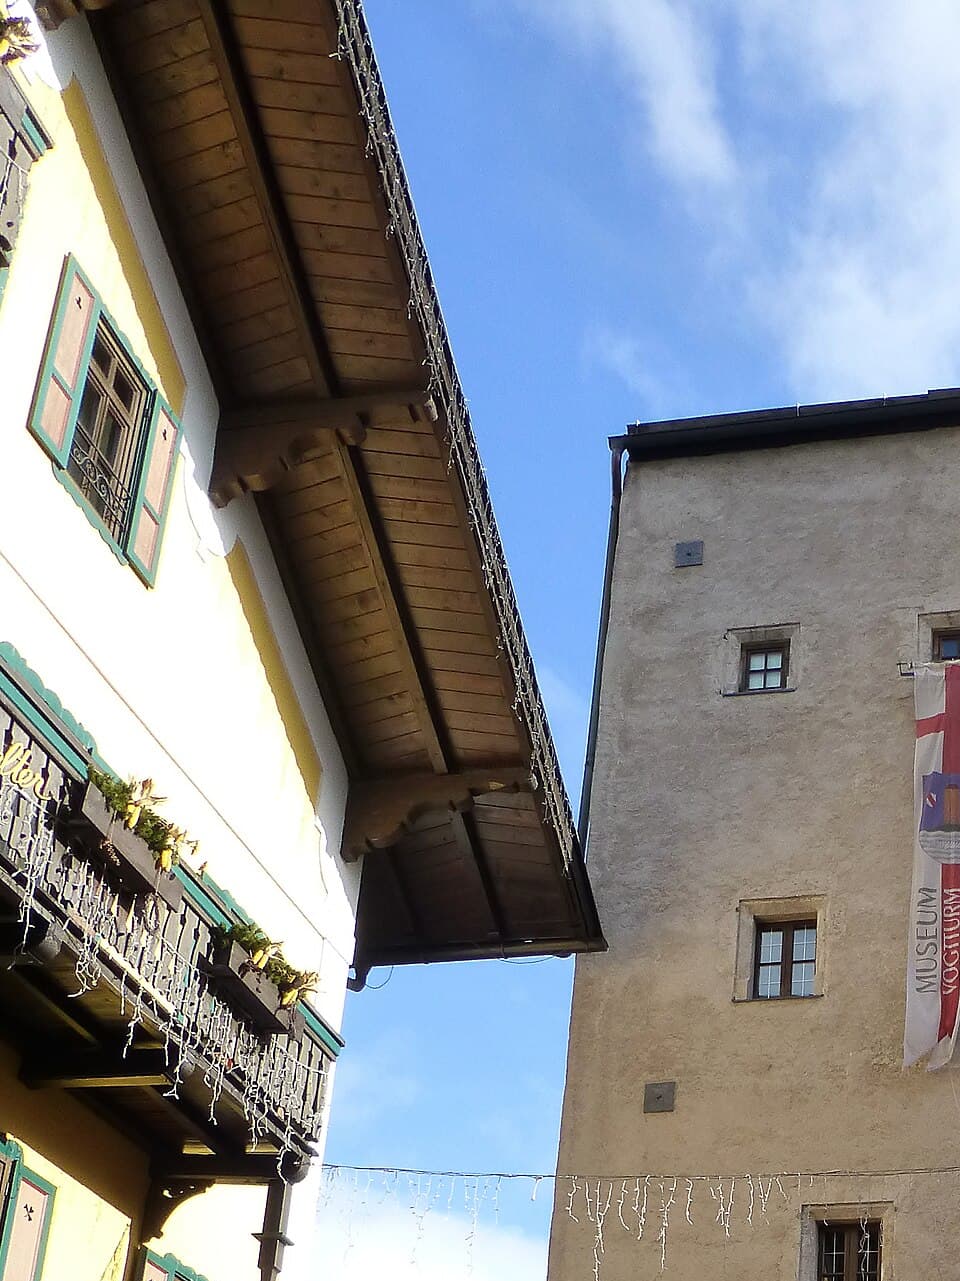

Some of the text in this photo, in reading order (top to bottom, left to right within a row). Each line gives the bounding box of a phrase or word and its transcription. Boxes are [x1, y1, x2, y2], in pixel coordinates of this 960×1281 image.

[0, 743, 52, 800] lter
[915, 887, 938, 994] MUSEUM
[942, 888, 960, 995] VOGTTURM
